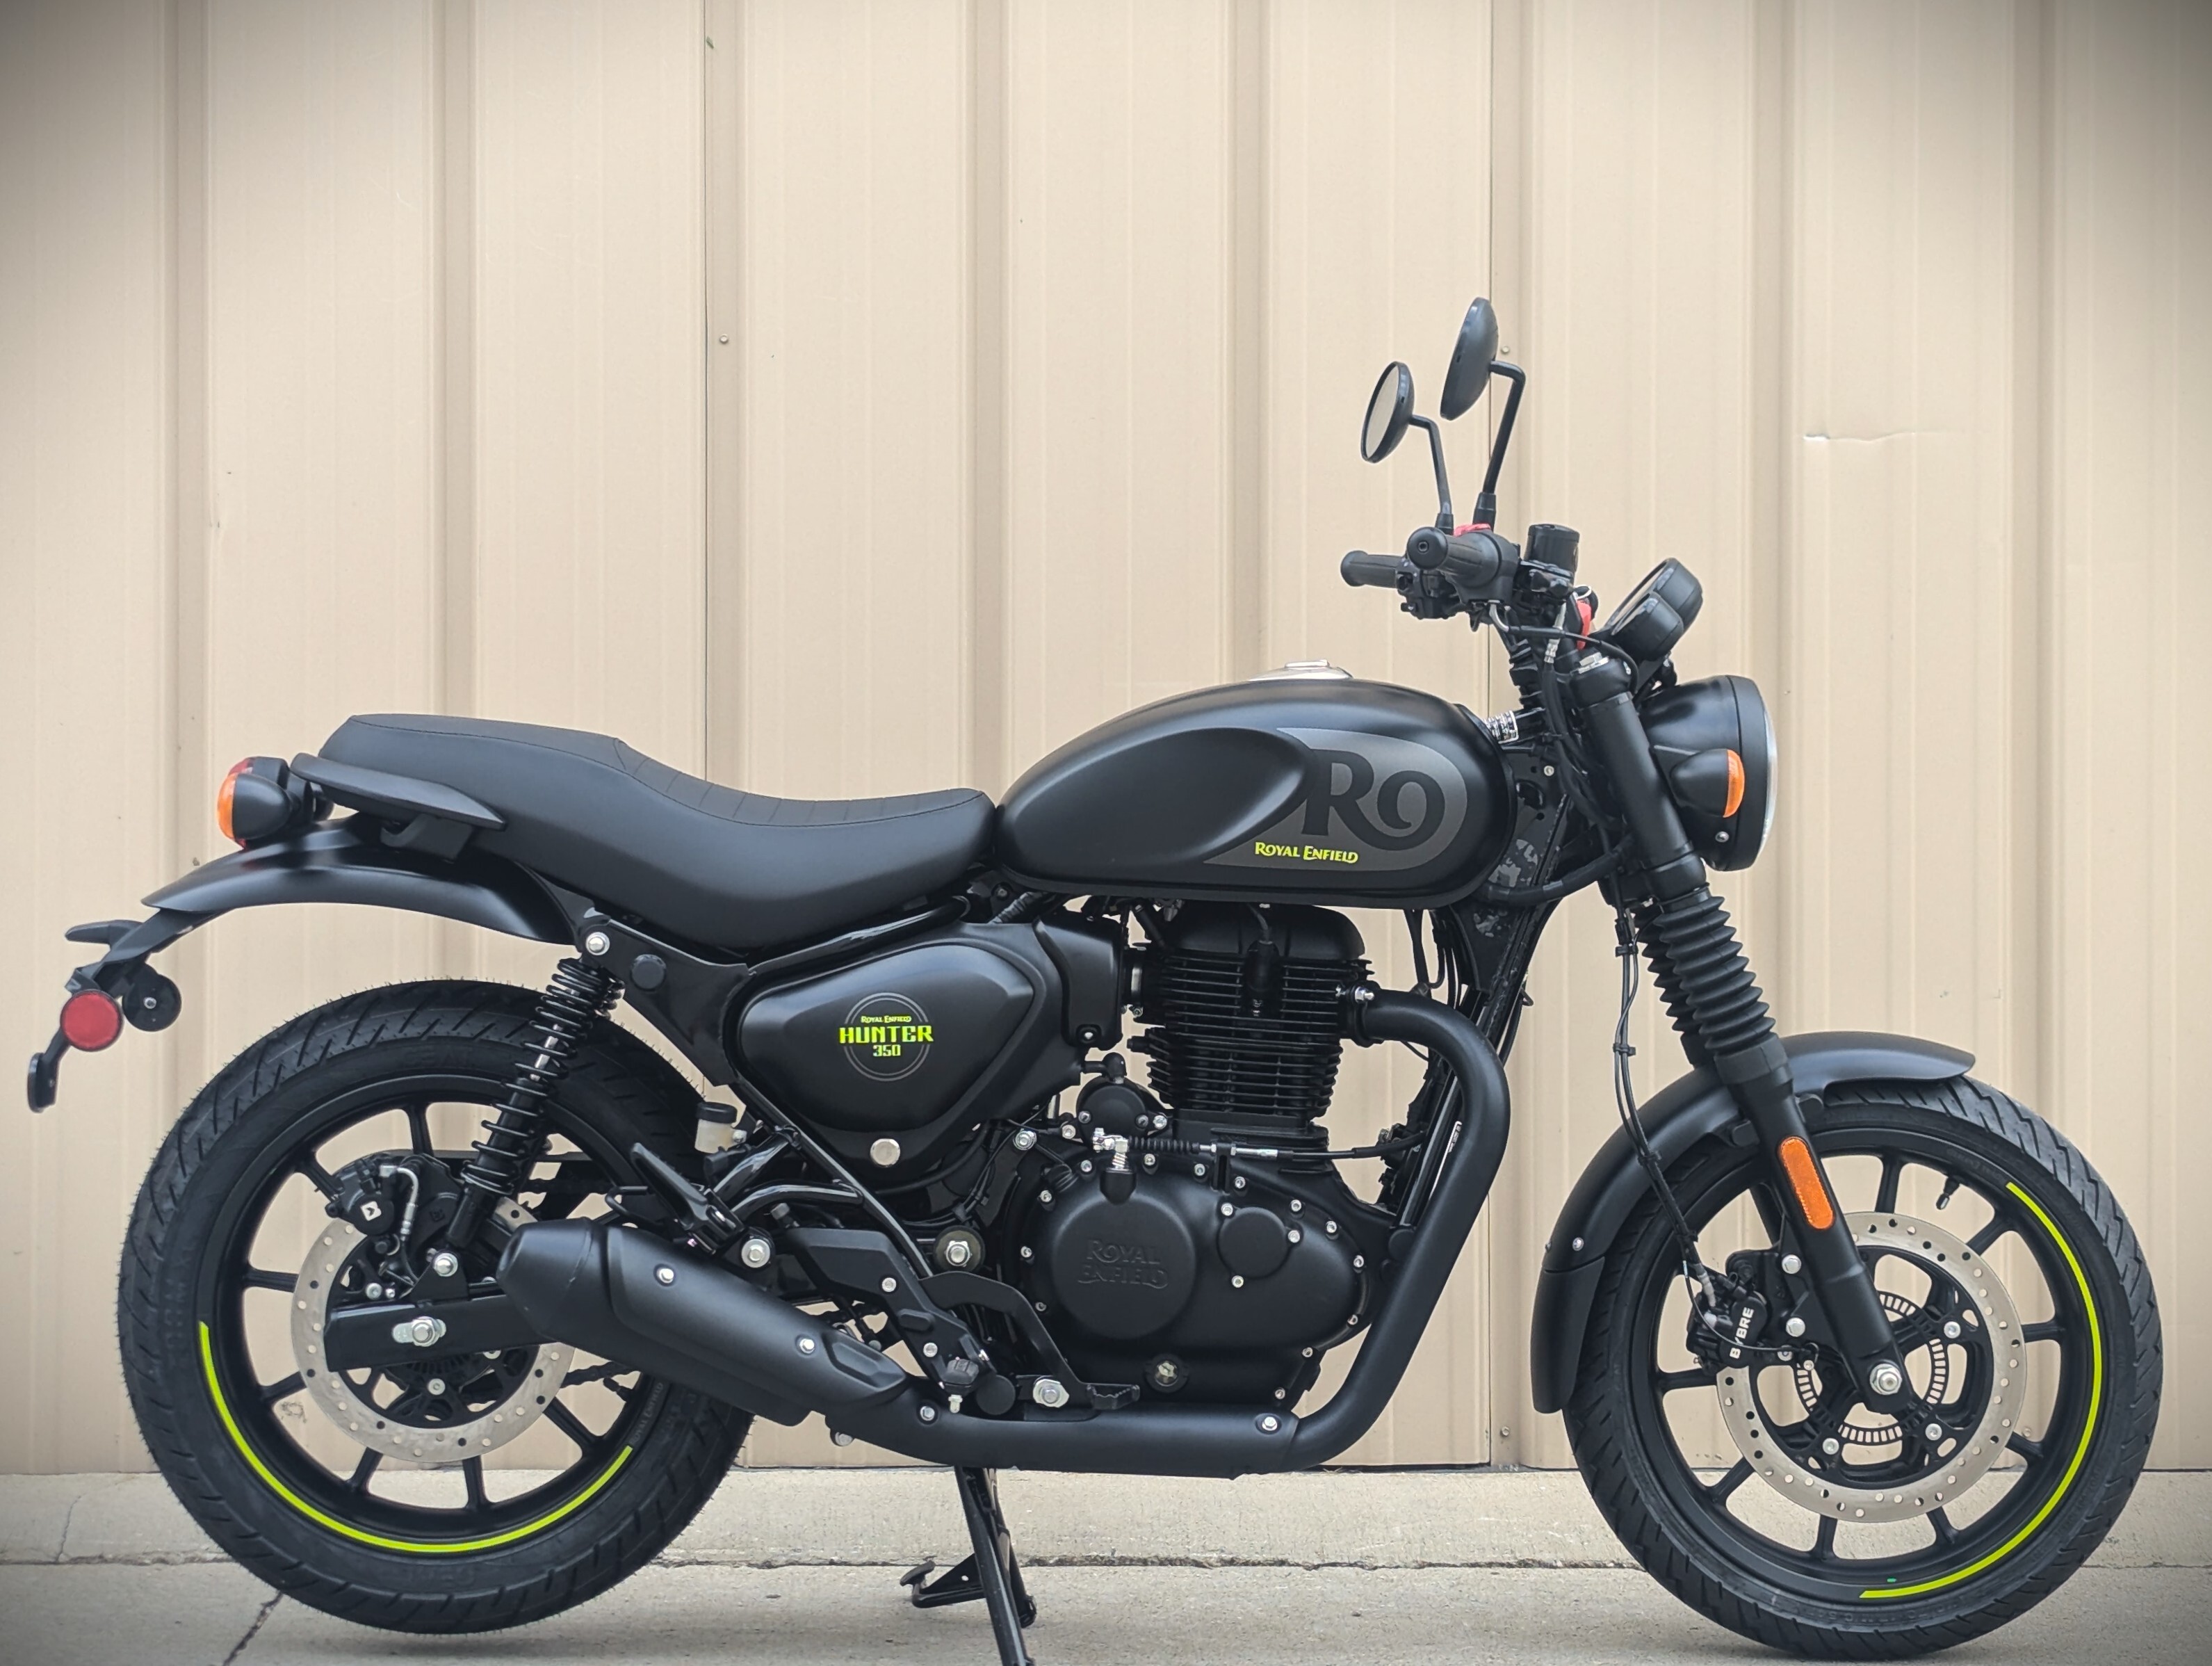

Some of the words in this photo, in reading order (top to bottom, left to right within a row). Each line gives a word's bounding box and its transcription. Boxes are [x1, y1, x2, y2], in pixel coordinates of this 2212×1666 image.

[1255, 841, 1300, 857] ROYAL
[1303, 846, 1358, 864] ENFIELD
[839, 1026, 934, 1044] HUNTER
[872, 1044, 901, 1057] 350
[1086, 1239, 1160, 1263] ROYAL
[1078, 1264, 1169, 1289] ENFIELD
